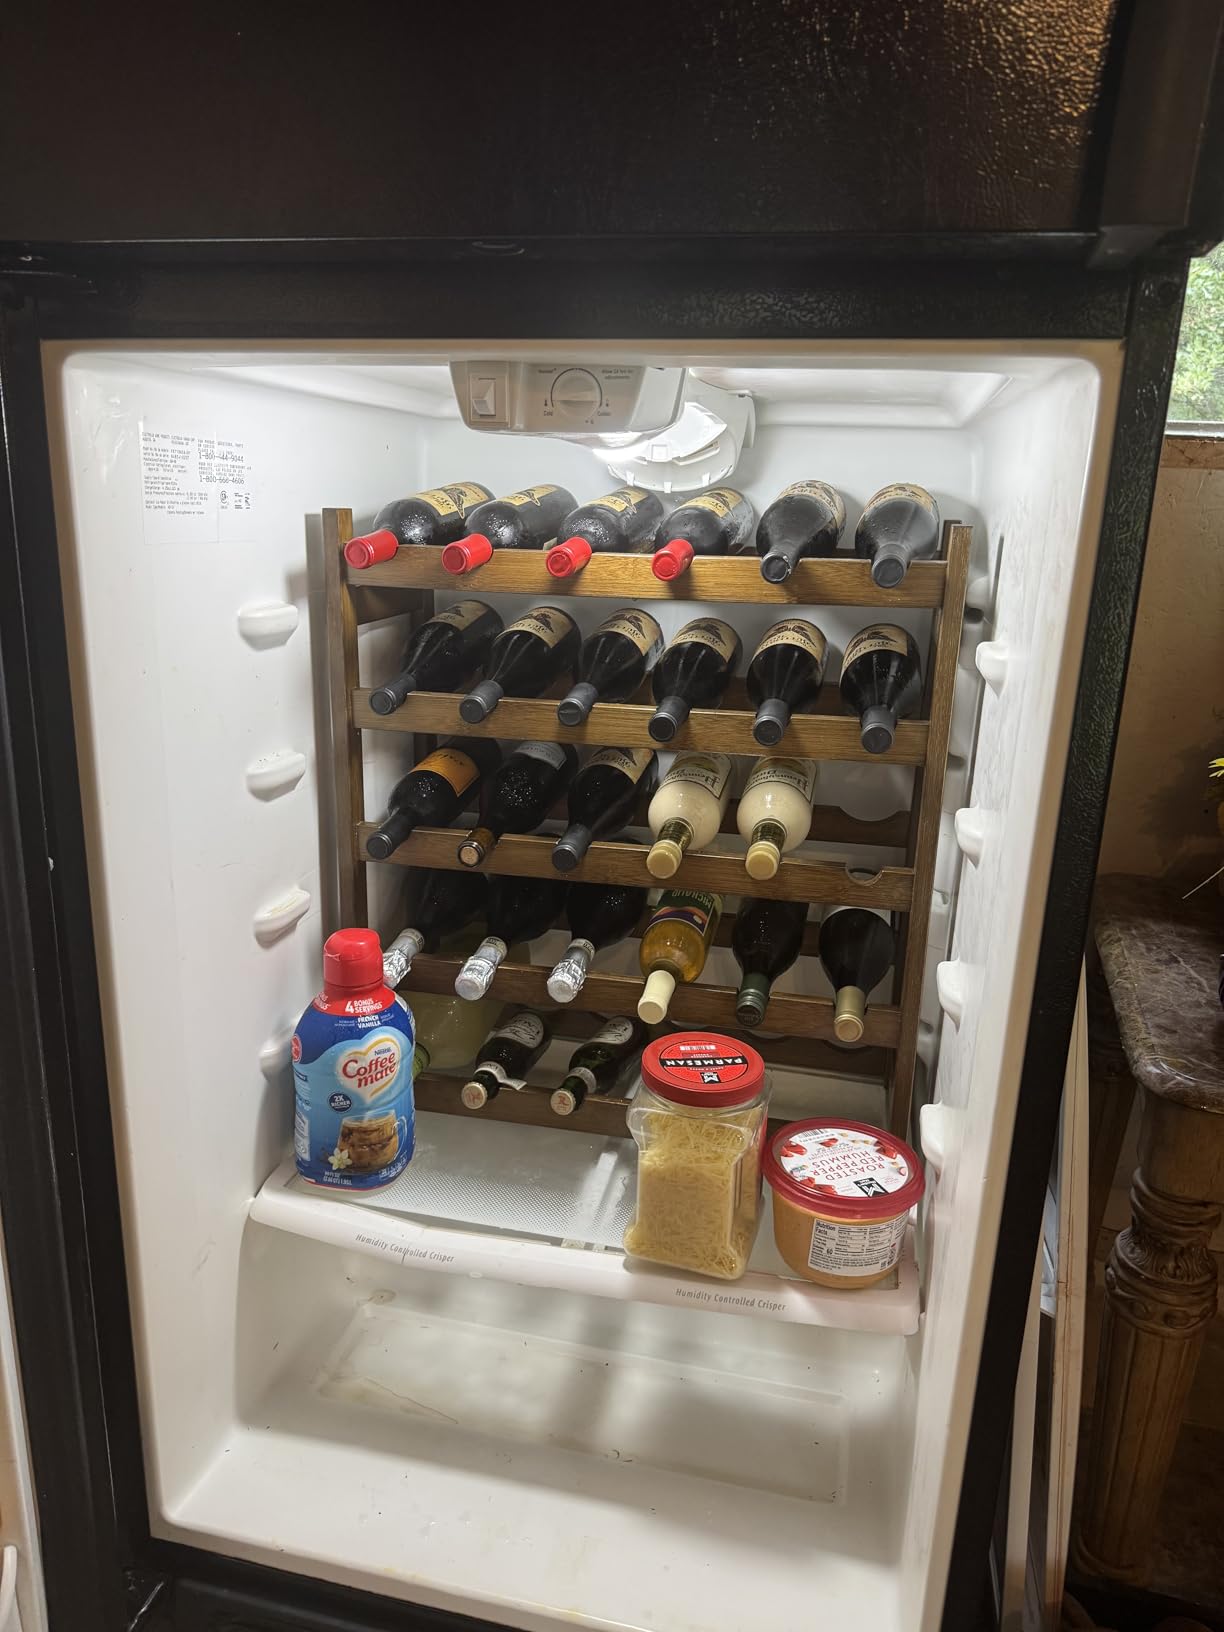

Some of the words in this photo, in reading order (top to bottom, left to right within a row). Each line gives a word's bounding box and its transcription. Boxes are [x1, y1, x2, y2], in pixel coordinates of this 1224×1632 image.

[344, 1001, 354, 1014] 4
[354, 998, 374, 1007] BONUS
[355, 1001, 383, 1014] SERVINGS
[357, 1020, 381, 1029] VANILLA
[342, 1052, 396, 1079] Coffee
[665, 1057, 743, 1067] PARMESAN
[357, 1062, 397, 1089] mate
[811, 1150, 871, 1169] HUMMUS
[860, 1155, 885, 1166] RED
[809, 1160, 856, 1177] PEPPER
[824, 1162, 885, 1182] ROASTED
[816, 1221, 836, 1231] Nutrition
[355, 1233, 389, 1250] Humidity
[390, 1243, 428, 1258] Controlled
[429, 1251, 455, 1263] Crisper
[675, 1288, 712, 1301] Humidity
[714, 1294, 755, 1307] Controlled
[757, 1299, 787, 1312] Crisper
